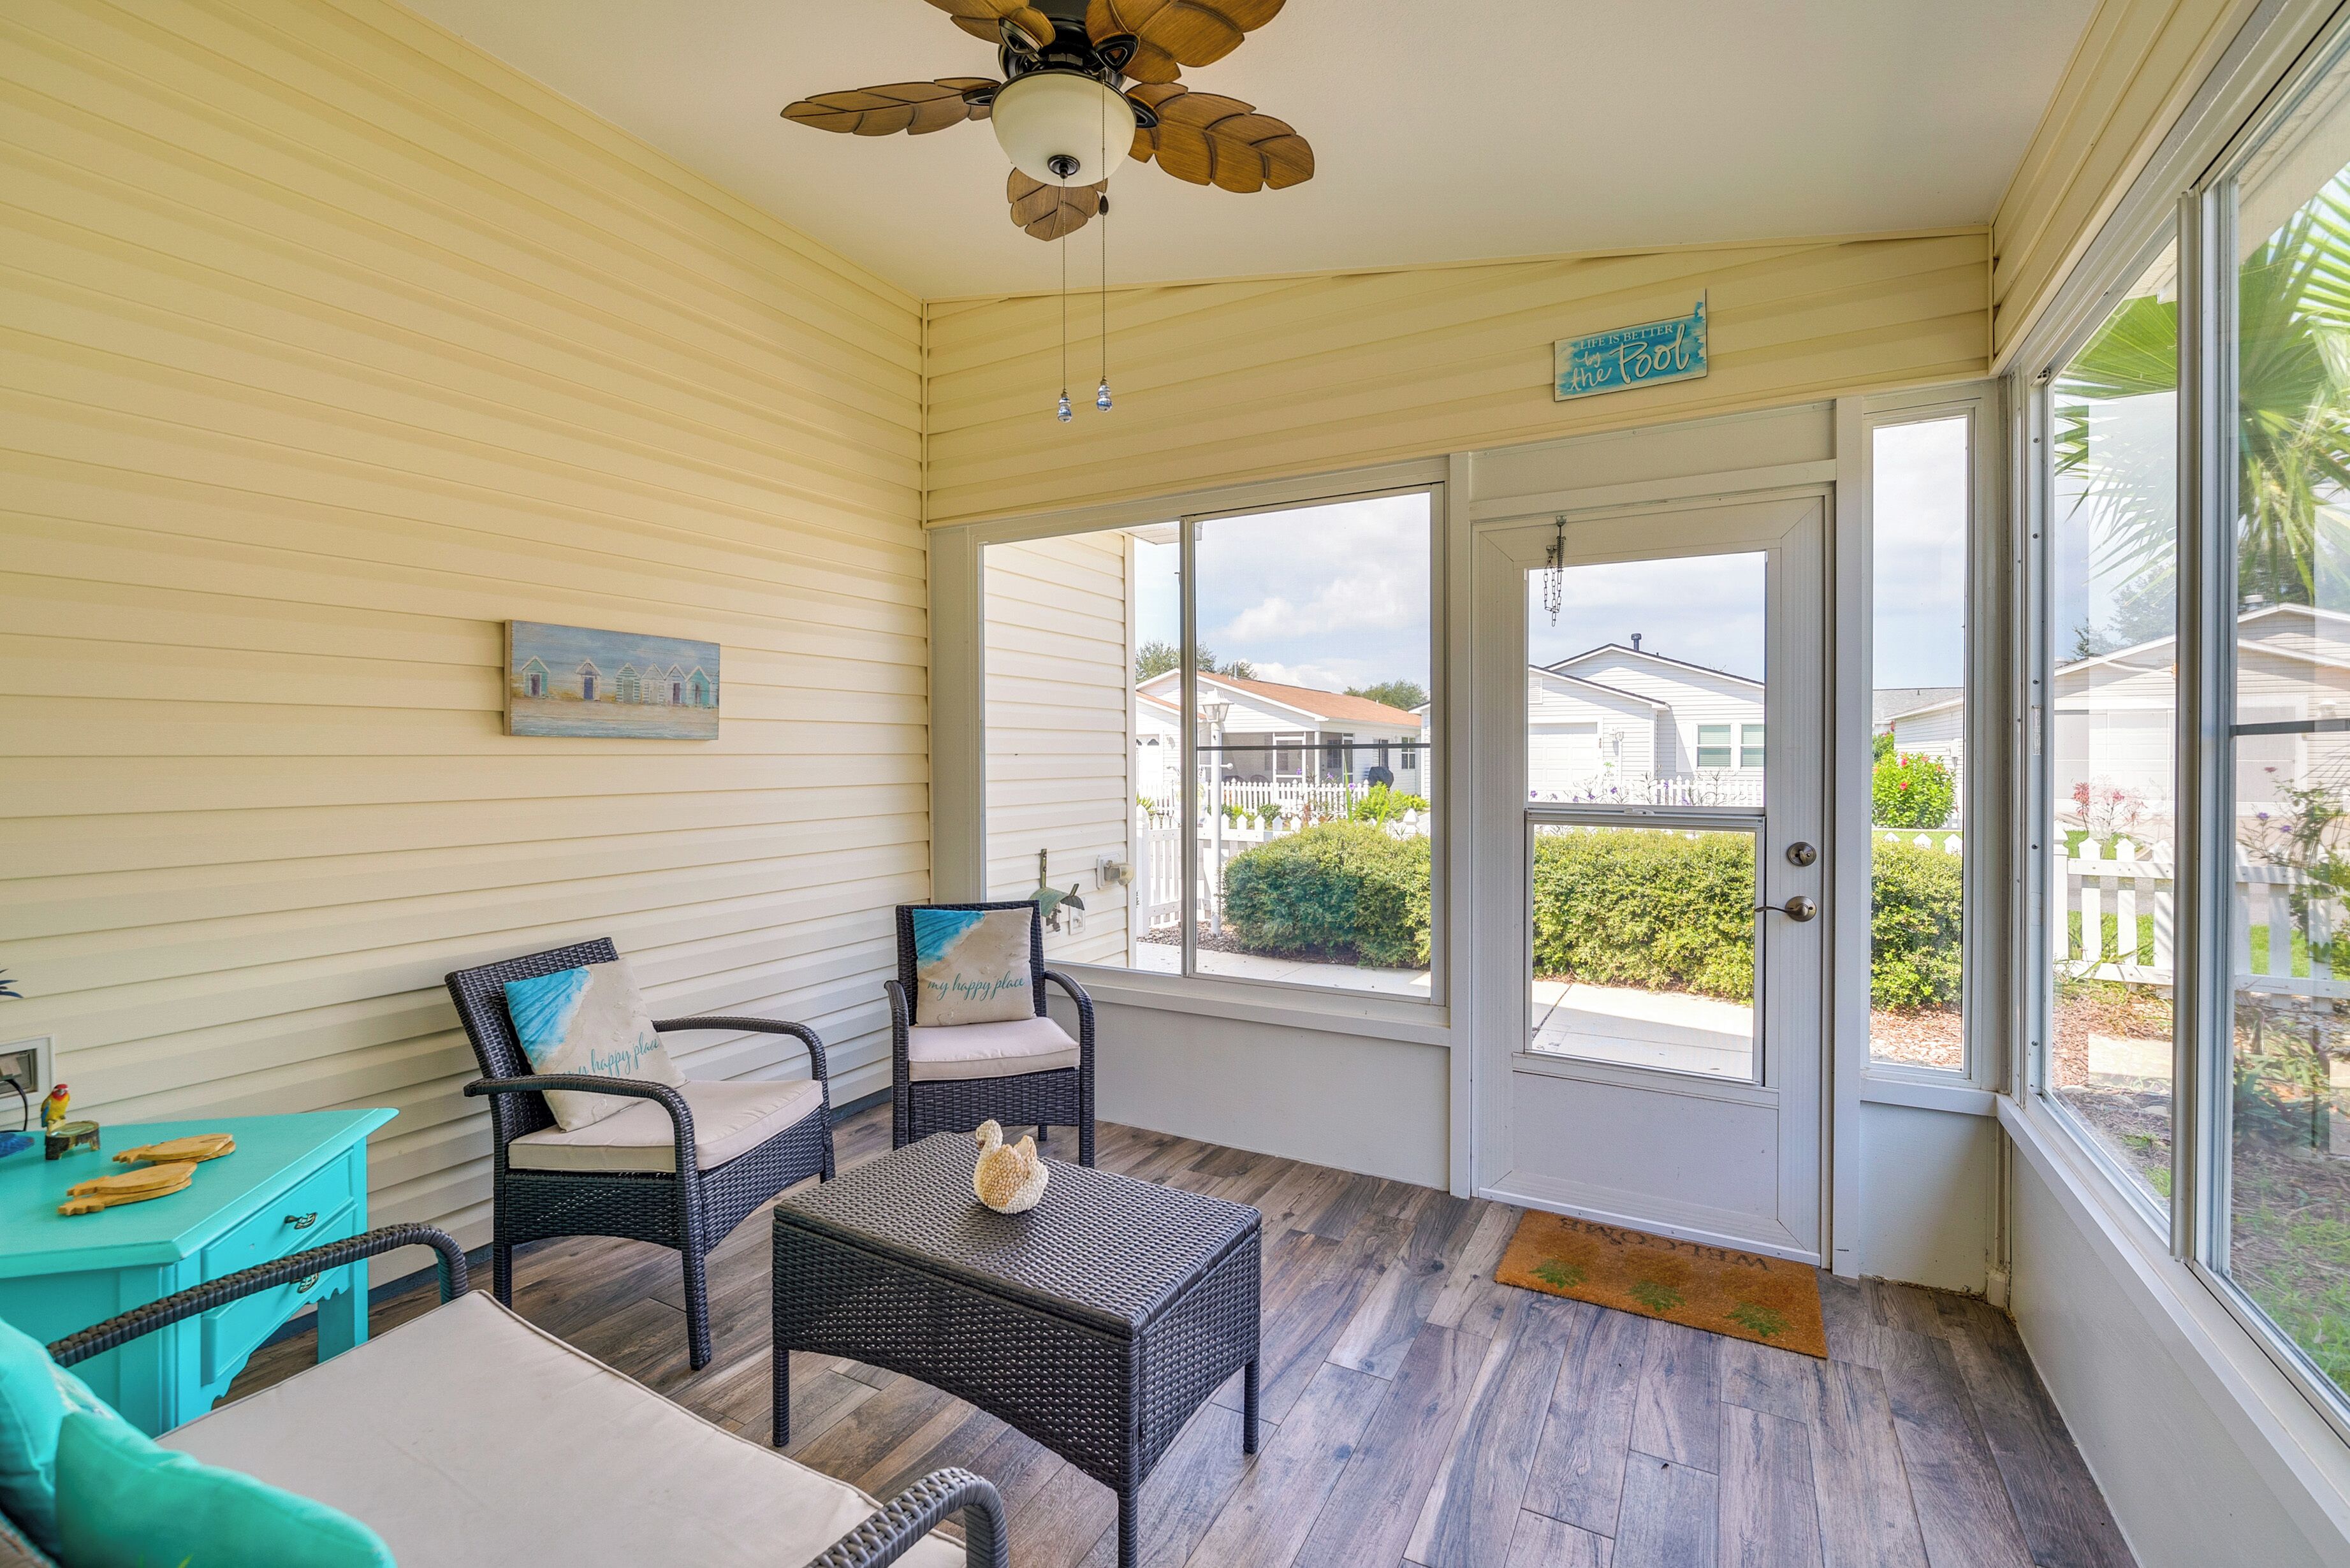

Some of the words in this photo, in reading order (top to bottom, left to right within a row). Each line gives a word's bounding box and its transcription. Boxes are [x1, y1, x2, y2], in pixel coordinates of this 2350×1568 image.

[1580, 337, 1605, 350] LIFE
[1609, 334, 1619, 344] IS
[1623, 324, 1673, 342] BETTER
[1567, 367, 1612, 392] the
[1609, 323, 1690, 384] Pool
[1575, 351, 1601, 368] by
[927, 979, 949, 1001] my
[952, 973, 992, 1001] happy
[990, 970, 1025, 999] place
[590, 1048, 631, 1077] happy
